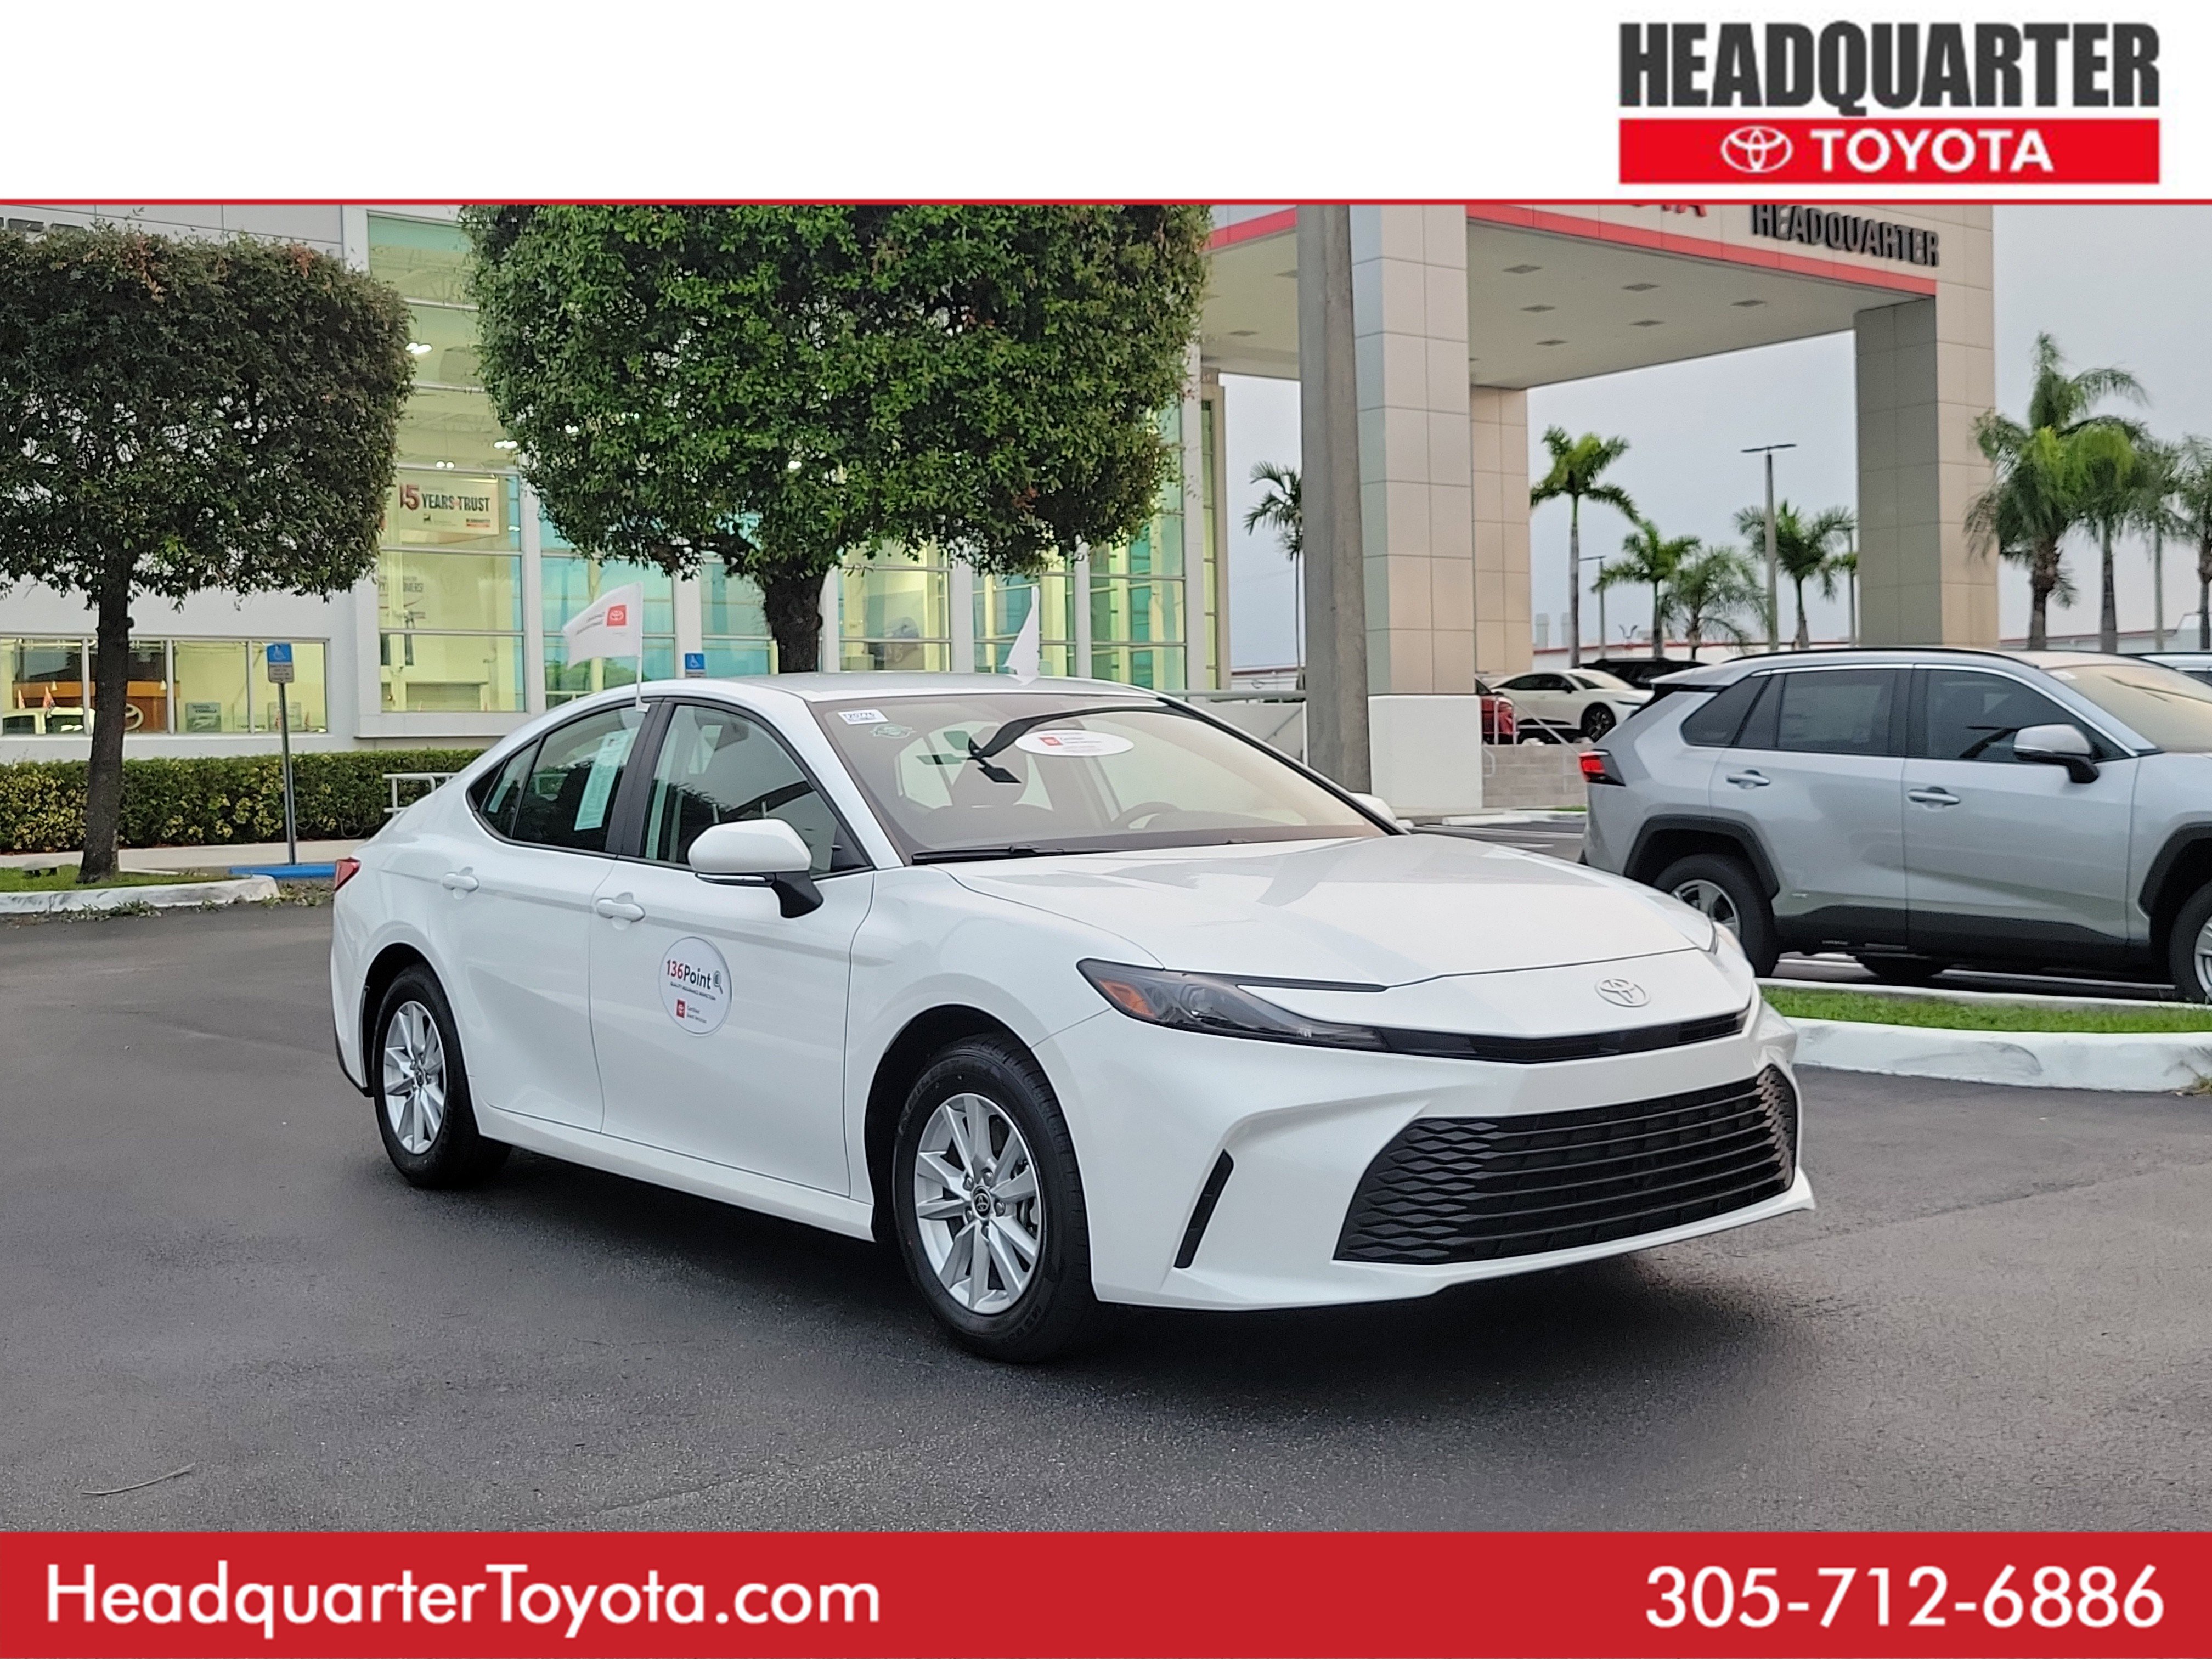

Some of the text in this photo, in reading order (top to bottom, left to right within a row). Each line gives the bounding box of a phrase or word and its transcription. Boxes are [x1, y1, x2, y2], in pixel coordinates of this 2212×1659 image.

[1752, 205, 1939, 267] HEADQUARTER
[421, 493, 455, 510] YEARS
[458, 495, 491, 512] TRUST
[667, 959, 712, 990] 136Point
